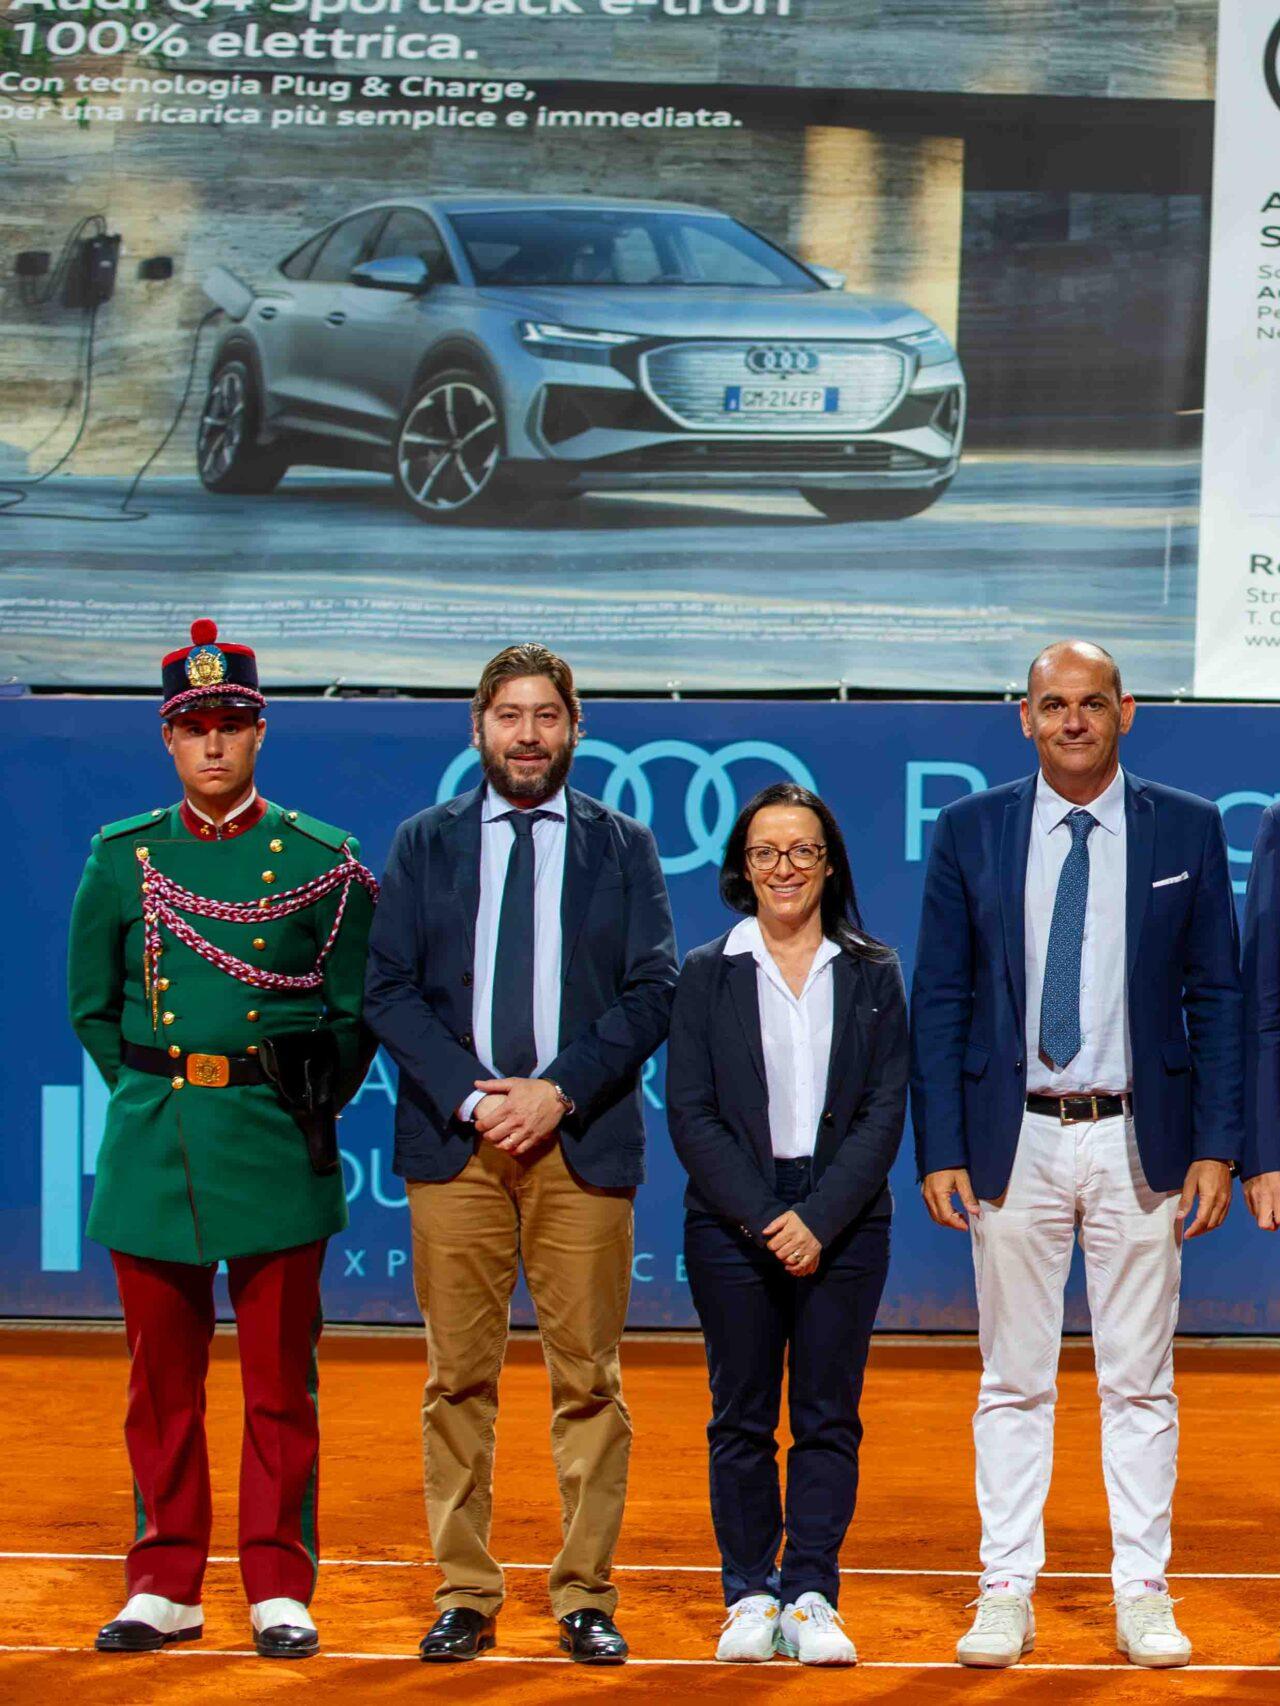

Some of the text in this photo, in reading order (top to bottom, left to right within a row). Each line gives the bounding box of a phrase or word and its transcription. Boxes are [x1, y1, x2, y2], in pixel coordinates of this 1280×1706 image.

[13, 21, 478, 59] 100% elettrica.
[0, 71, 537, 103] Con tecnologia Plug & Charge,
[61, 105, 125, 121] una
[134, 103, 261, 124] ricarica
[271, 104, 327, 129] più
[336, 105, 498, 130] semplice
[506, 111, 529, 127] e
[537, 106, 743, 127] immediata.
[1246, 610, 1262, 625] T.
